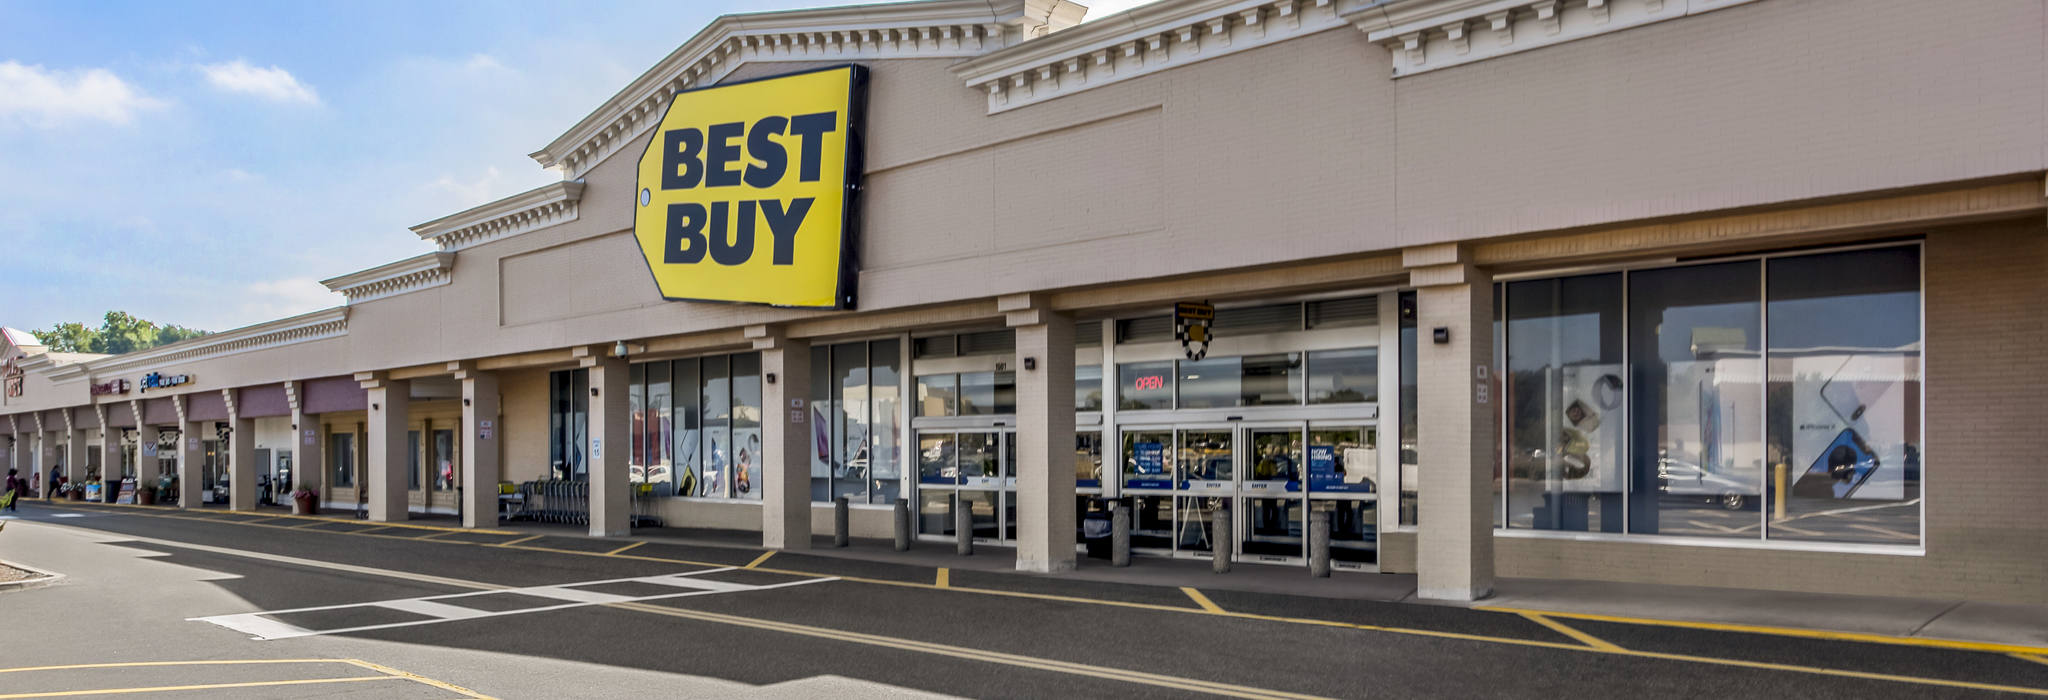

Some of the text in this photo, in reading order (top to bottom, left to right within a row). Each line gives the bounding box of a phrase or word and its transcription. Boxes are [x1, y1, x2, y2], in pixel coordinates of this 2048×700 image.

[661, 111, 837, 191] BEST
[664, 197, 816, 266] BUY
[1136, 376, 1163, 391] OPEN
[1311, 448, 1328, 456] NOW
